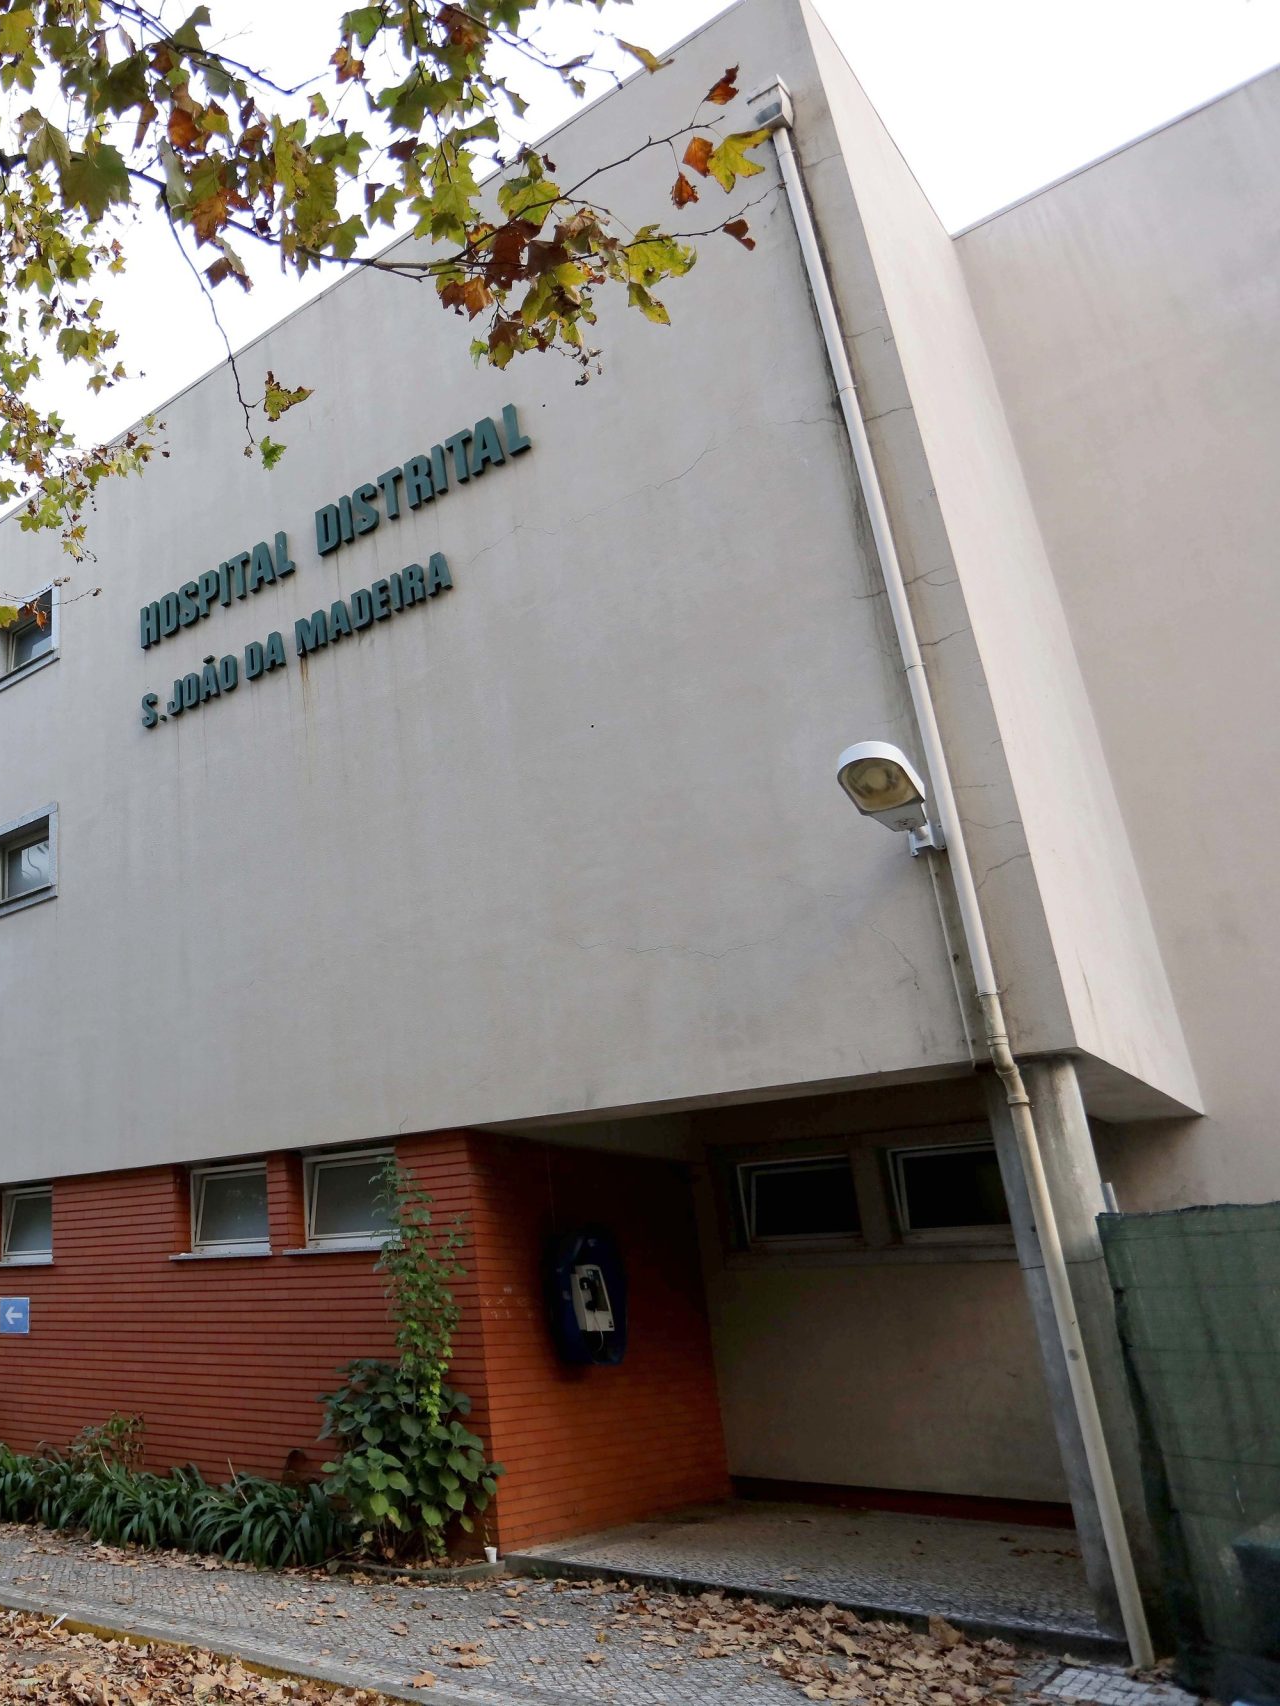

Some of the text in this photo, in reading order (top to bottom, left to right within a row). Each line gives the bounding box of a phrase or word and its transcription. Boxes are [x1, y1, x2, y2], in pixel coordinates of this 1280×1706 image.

[139, 403, 532, 650] HOSPITAL DISTRITAL
[245, 630, 287, 681] DA
[294, 551, 454, 658] MADEIRA
